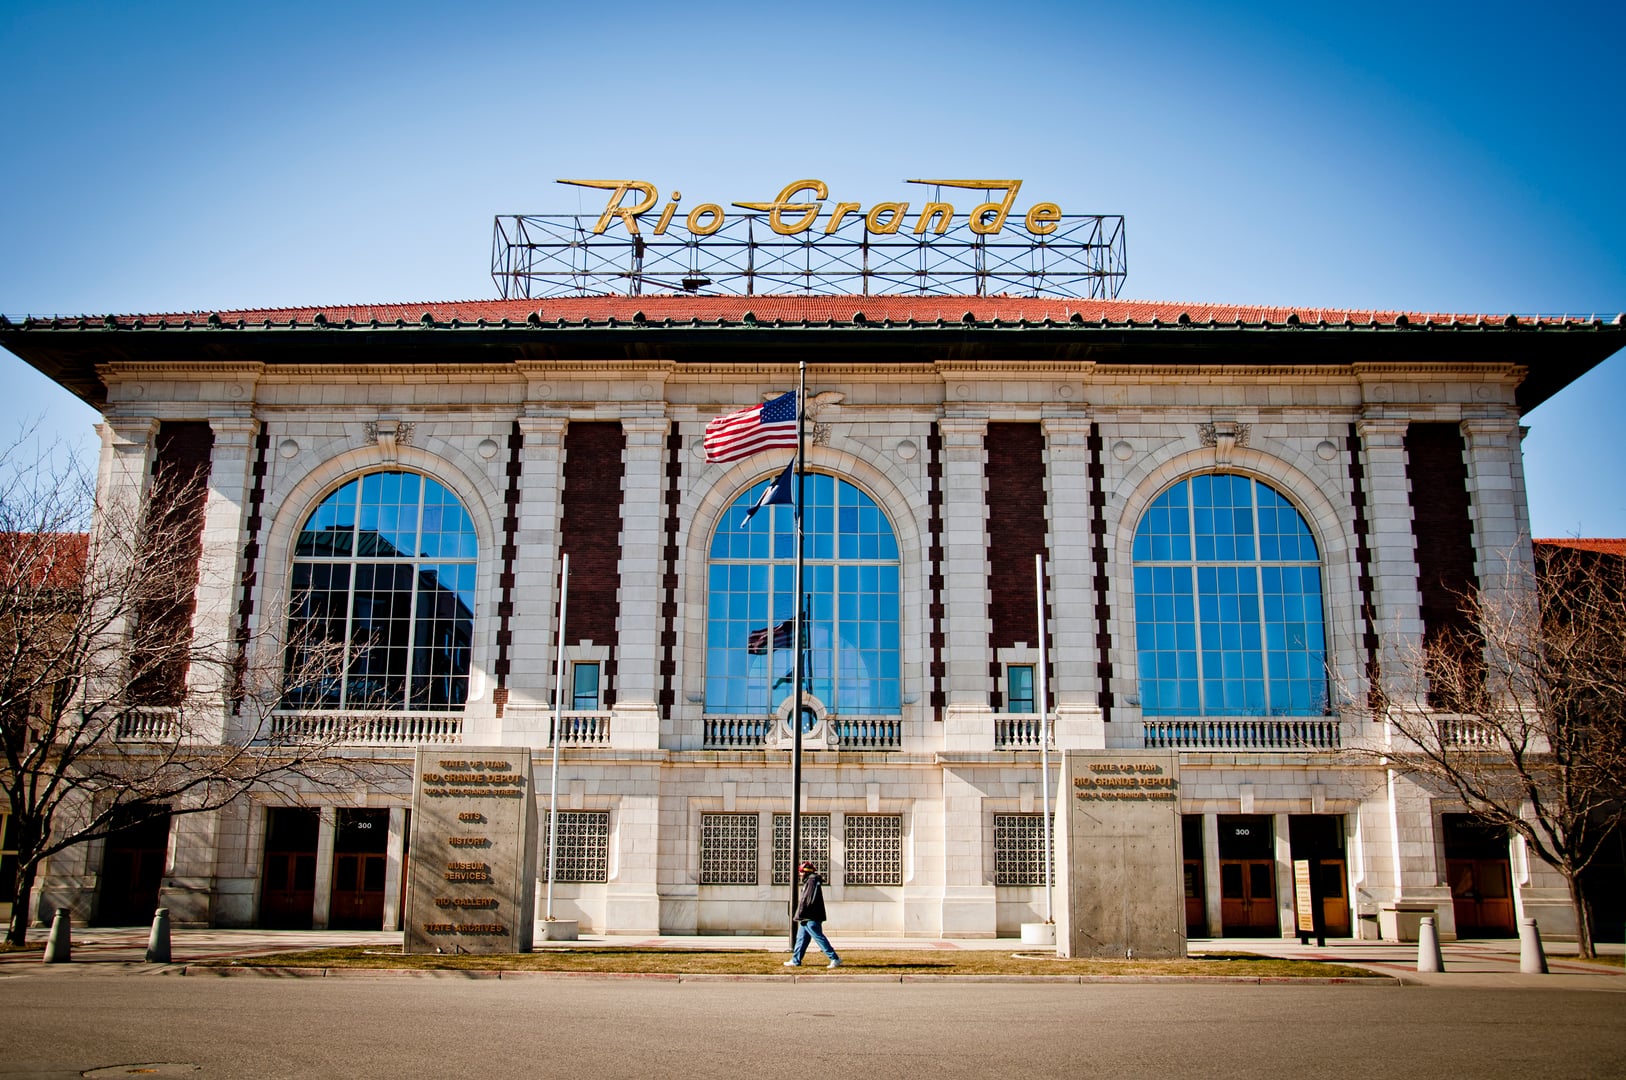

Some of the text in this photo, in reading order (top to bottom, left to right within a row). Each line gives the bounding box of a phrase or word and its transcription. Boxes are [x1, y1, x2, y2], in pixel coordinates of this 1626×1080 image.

[556, 178, 1062, 235] Rio Grande
[438, 760, 465, 768] STATE
[469, 760, 480, 768] OF
[1088, 763, 1115, 771] STATE
[422, 773, 520, 783] RIO GRANDE DEPOT
[1073, 777, 1171, 786] RIO GRANDE DEPOT
[458, 812, 481, 820] ARTS
[448, 837, 487, 845] HISTORY
[447, 862, 485, 870] MUSEUM
[444, 872, 488, 880] SERVICES
[435, 898, 494, 906] RIO GALLERY
[423, 923, 503, 932] STATE ARCHIVES
